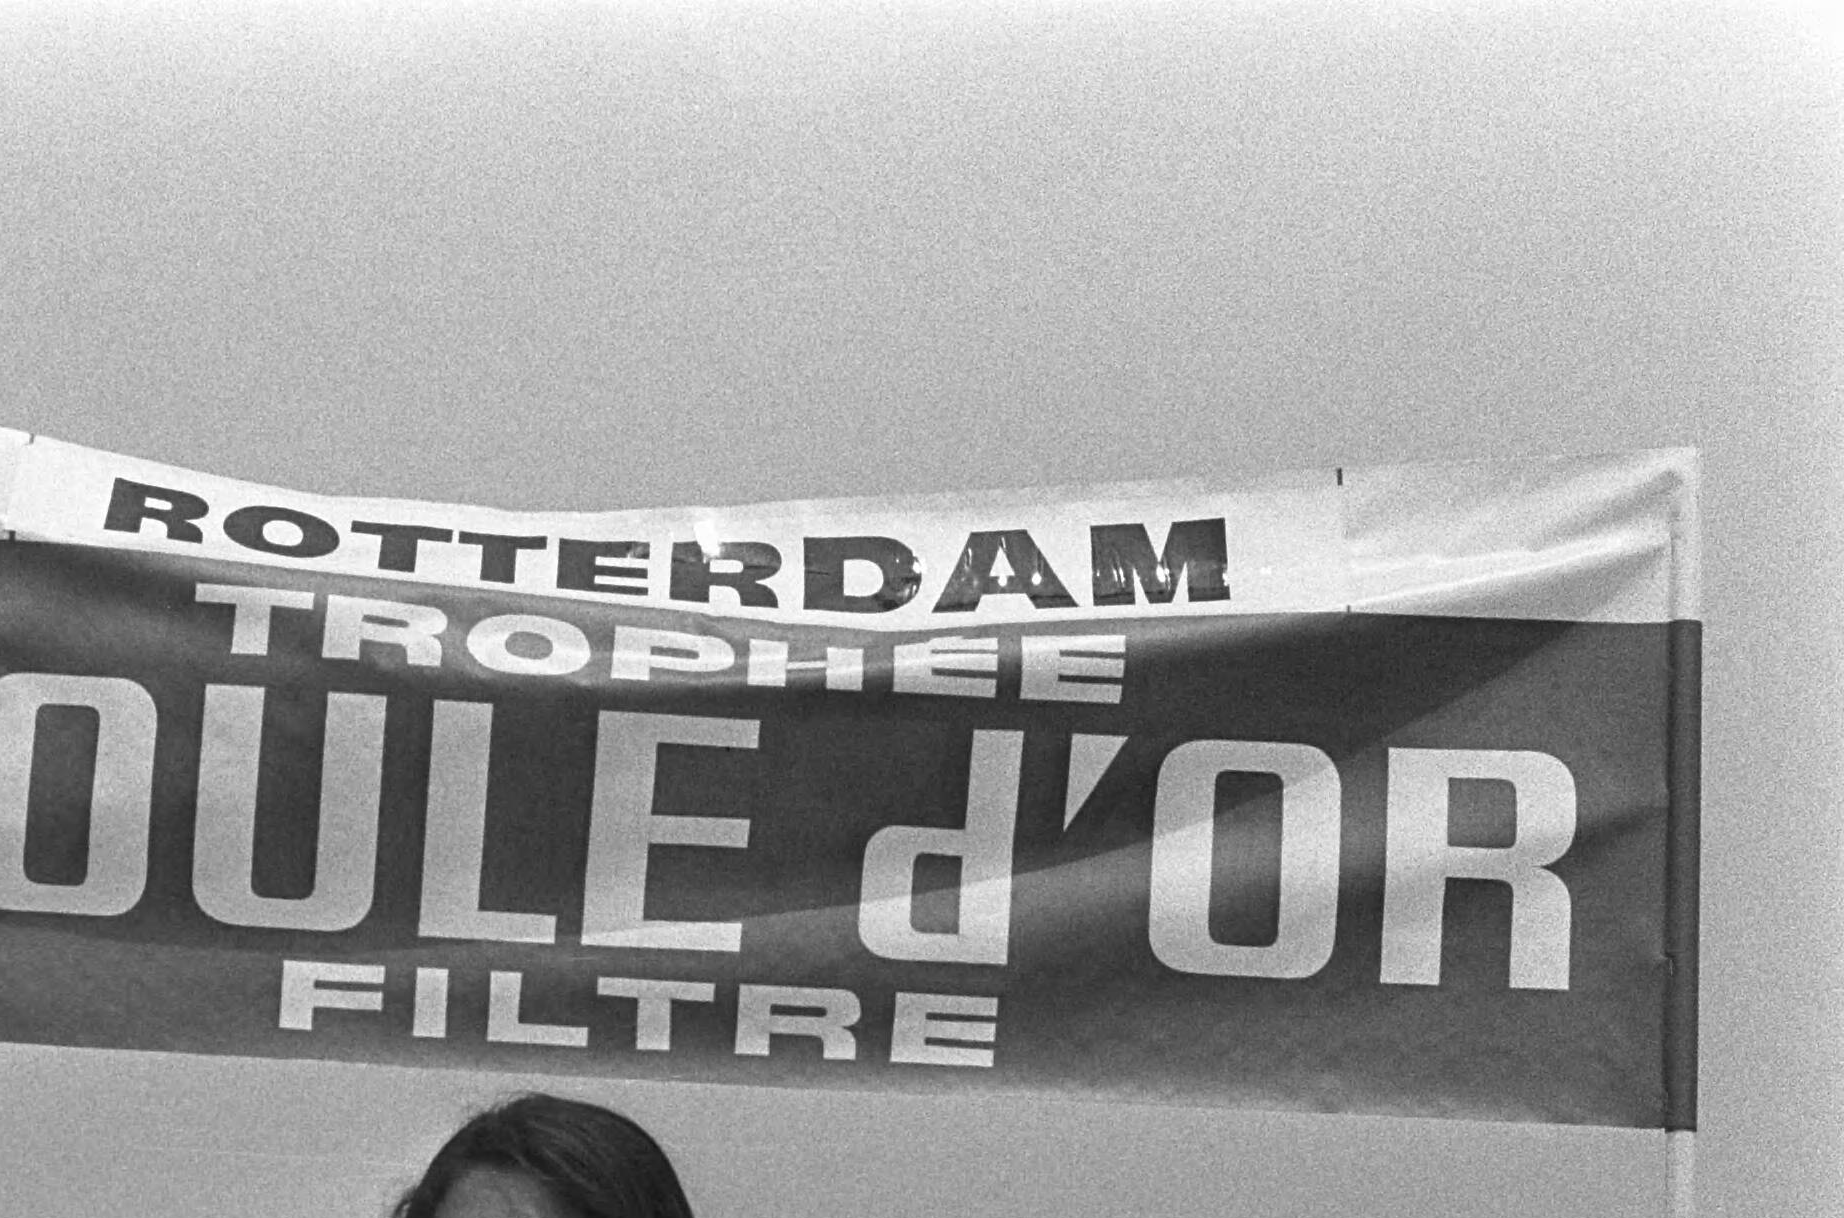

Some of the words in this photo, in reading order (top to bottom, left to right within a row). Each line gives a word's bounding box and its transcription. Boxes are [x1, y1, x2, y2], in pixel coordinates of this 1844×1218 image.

[103, 477, 1231, 616] ROTTERDAM
[858, 728, 1577, 991] d'OR
[277, 960, 999, 1068] FILTRE
